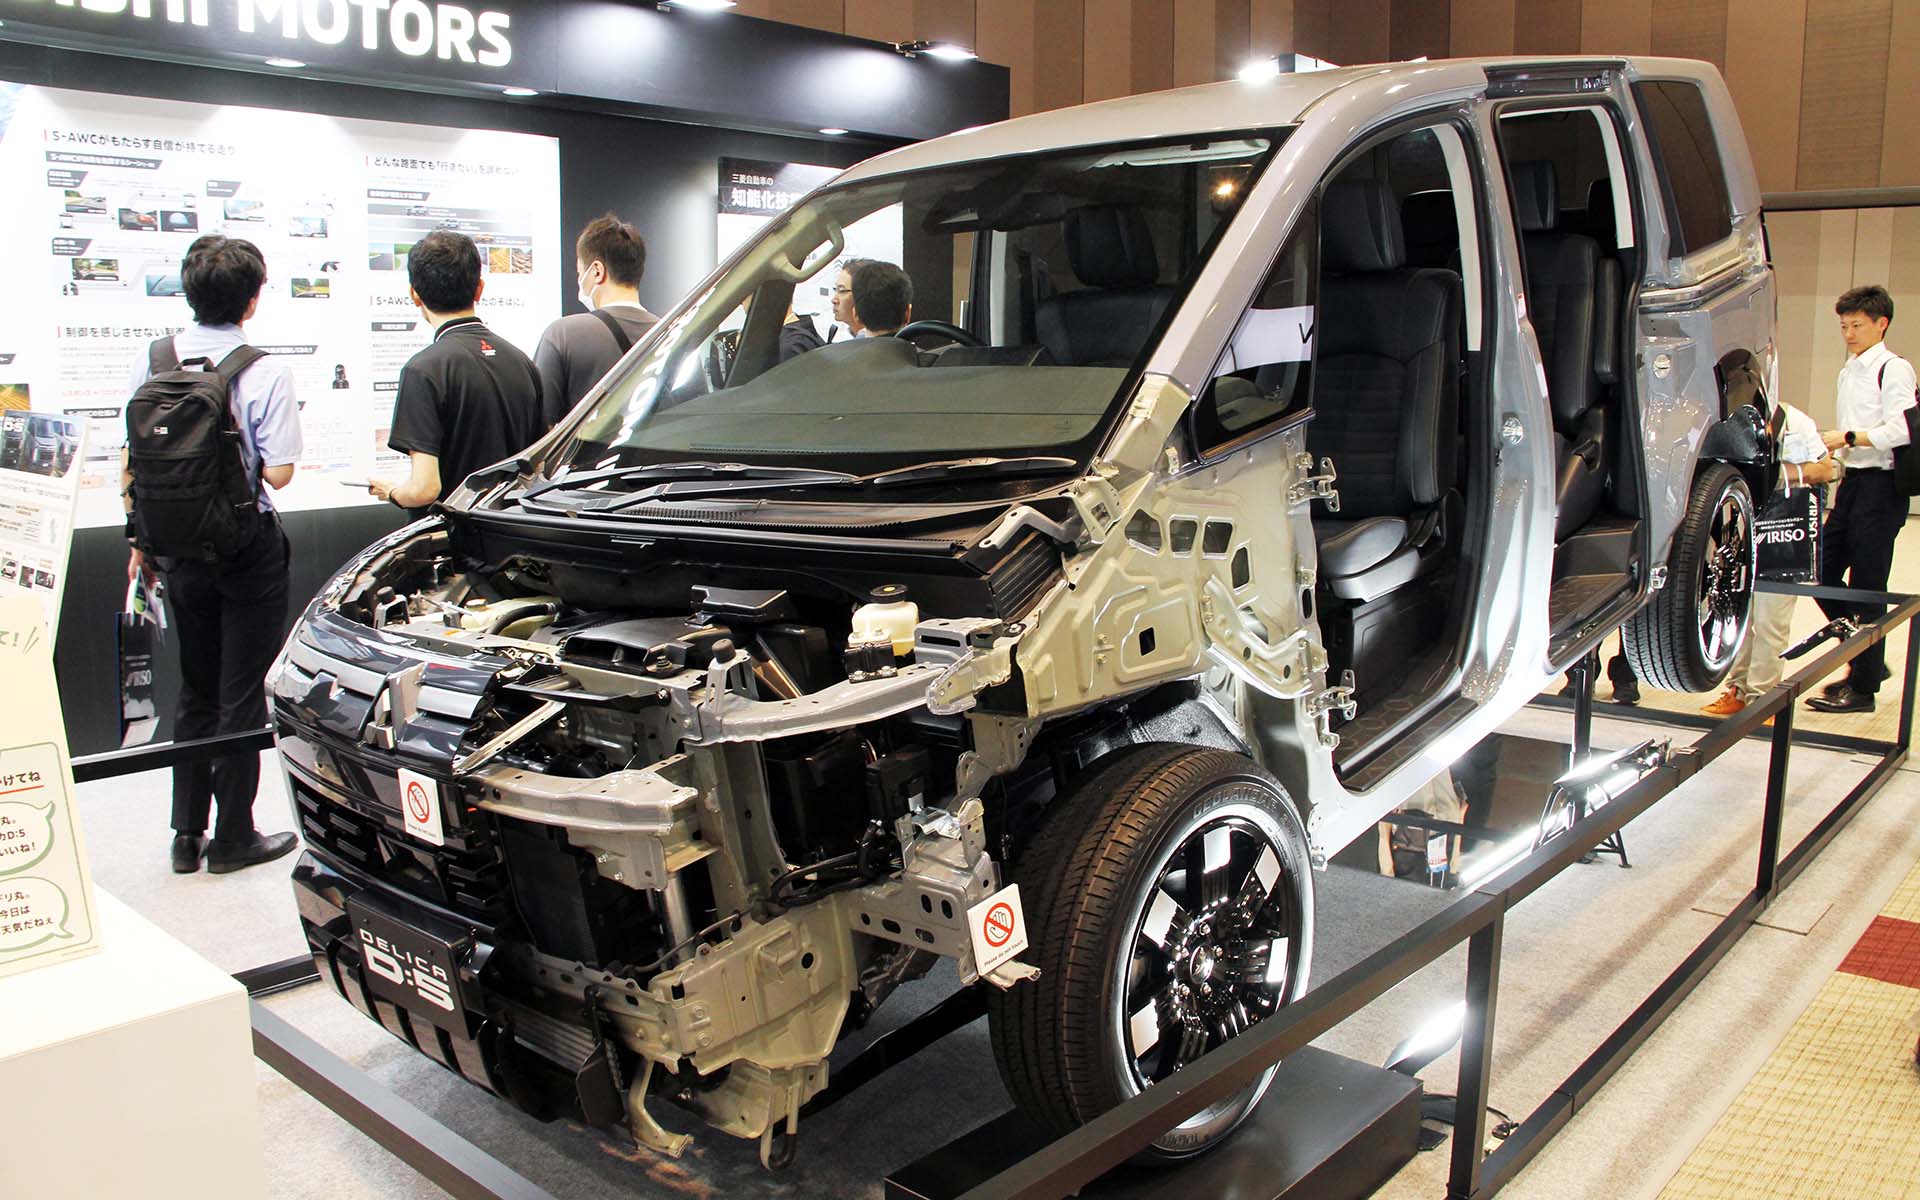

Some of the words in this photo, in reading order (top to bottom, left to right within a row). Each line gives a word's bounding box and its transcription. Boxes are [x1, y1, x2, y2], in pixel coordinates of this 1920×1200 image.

[237, 0, 512, 67] MOTORS
[732, 174, 773, 185] 三菱自動車の
[1768, 529, 1805, 543] IRISO
[0, 771, 41, 786] けてね
[0, 891, 30, 902] リ丸。
[359, 928, 448, 982] DELICA
[363, 943, 455, 1012] D:5
